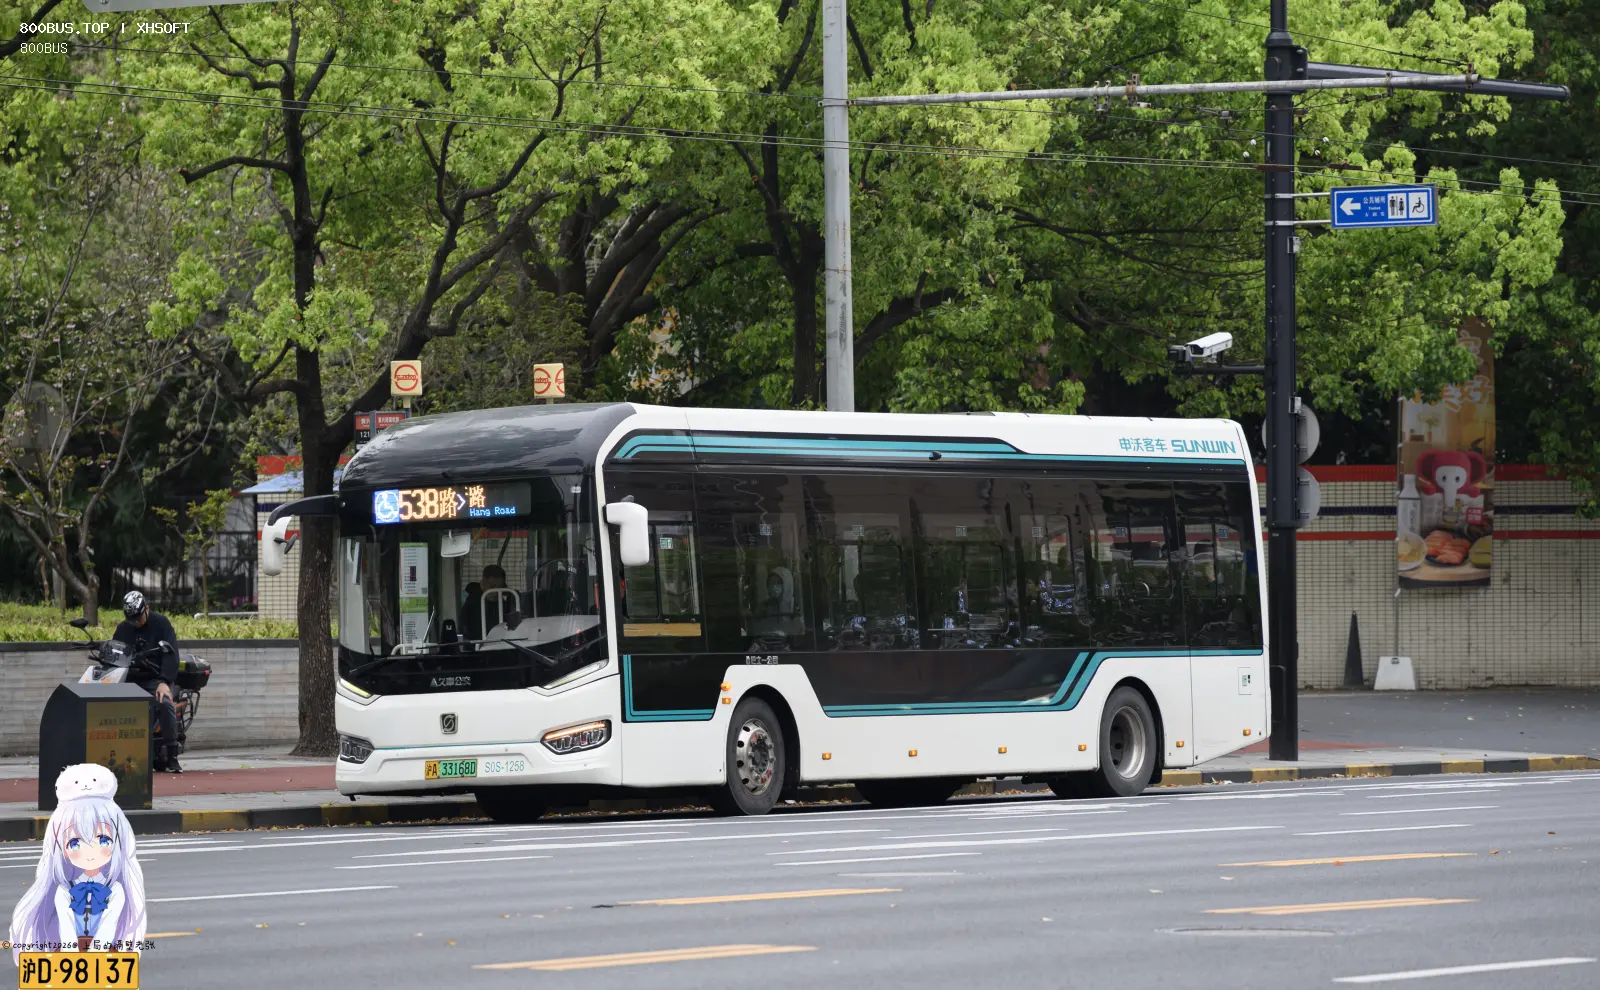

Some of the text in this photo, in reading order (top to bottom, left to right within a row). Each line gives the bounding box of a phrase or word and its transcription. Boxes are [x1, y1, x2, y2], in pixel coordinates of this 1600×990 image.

[1119, 437, 1237, 454] 申沃客车 SUNWIN
[400, 487, 458, 521] 538路
[469, 506, 516, 517] Hang Road
